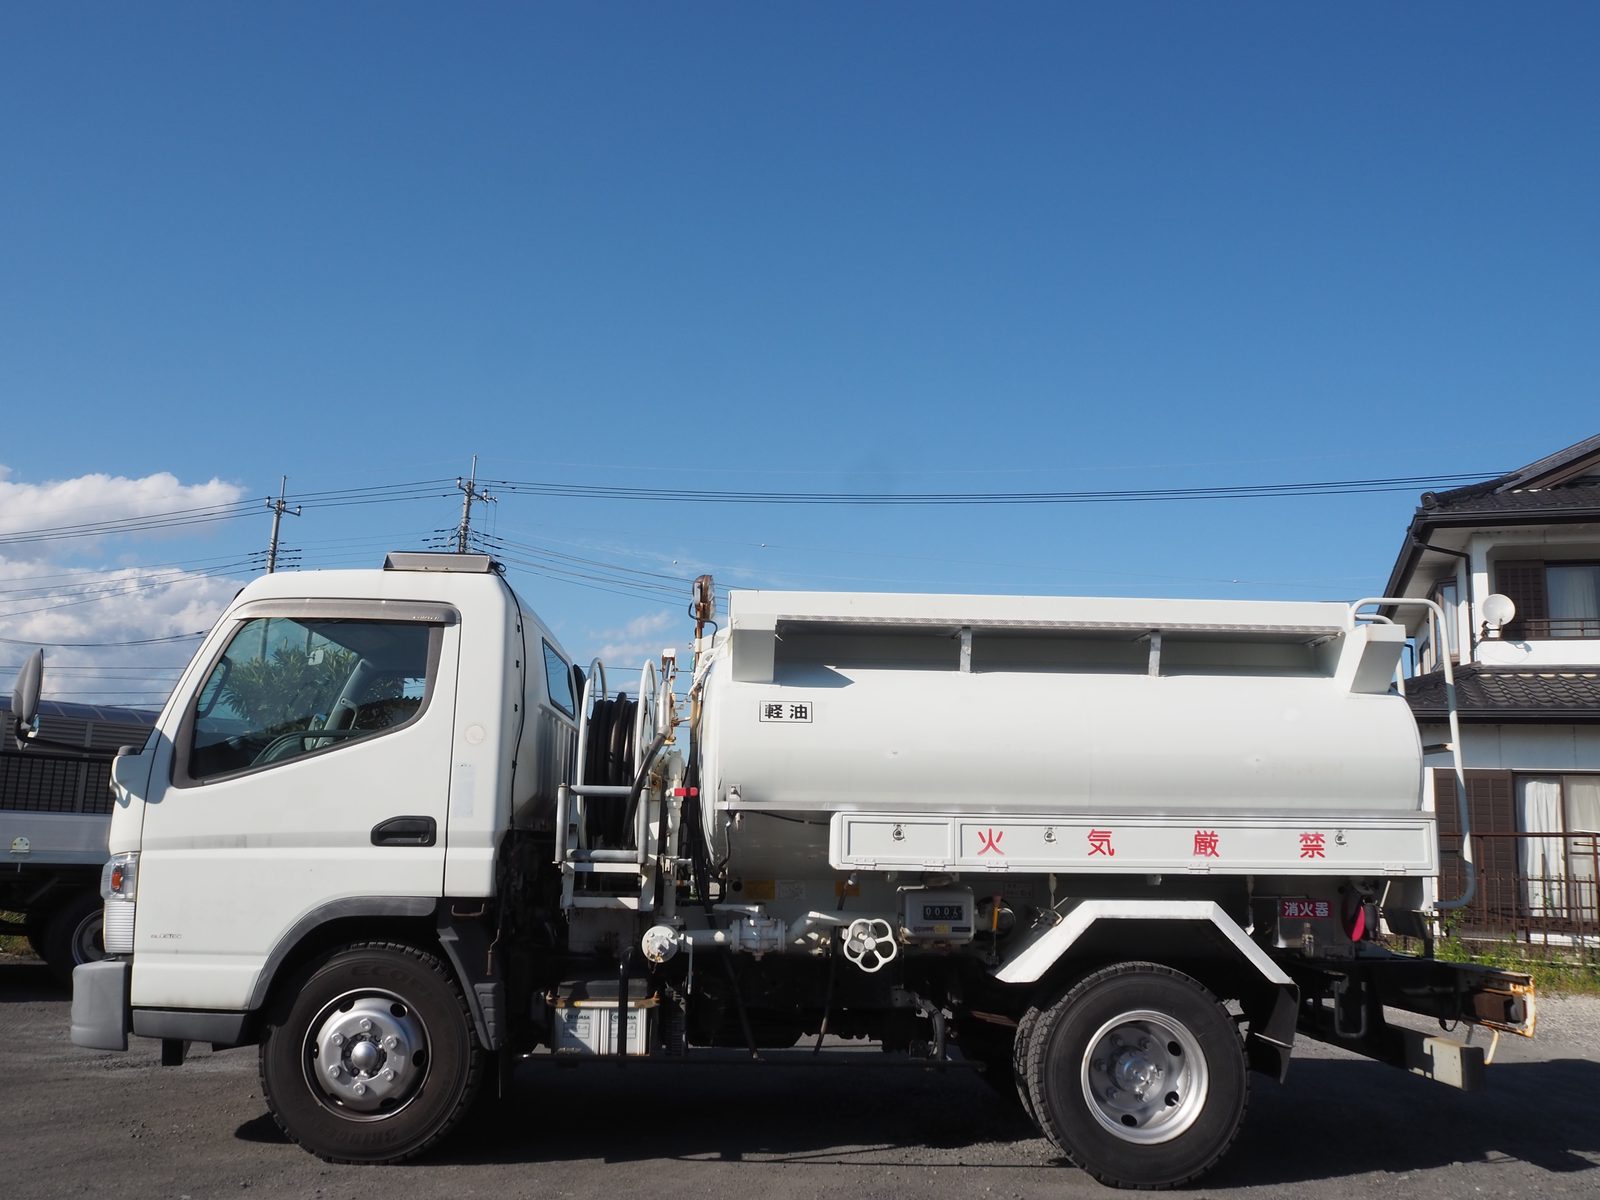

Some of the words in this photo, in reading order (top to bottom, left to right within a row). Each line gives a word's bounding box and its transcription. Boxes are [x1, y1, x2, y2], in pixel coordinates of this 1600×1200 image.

[764, 703, 808, 720] 軽油
[976, 827, 1326, 859] 火気厳禁
[1284, 901, 1329, 917] 消火器
